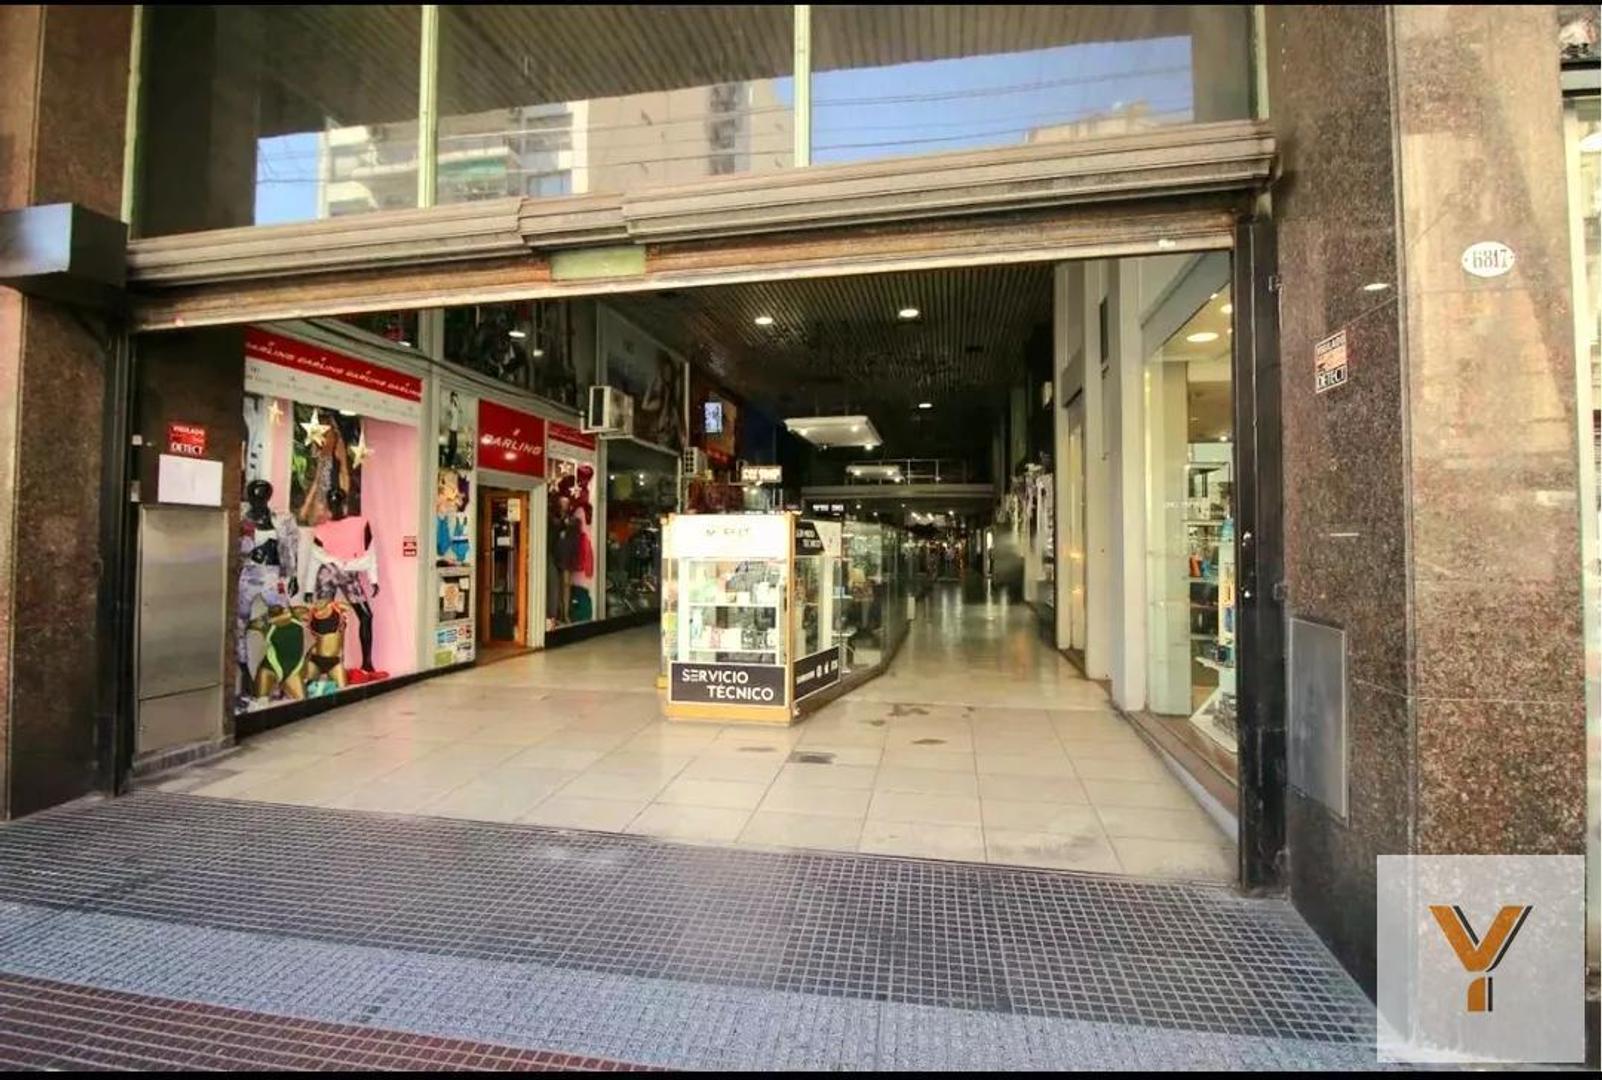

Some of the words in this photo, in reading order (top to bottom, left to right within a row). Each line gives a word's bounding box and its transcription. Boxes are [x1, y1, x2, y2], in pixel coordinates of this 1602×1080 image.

[1472, 249, 1508, 268] 6817
[1316, 367, 1346, 388] DETECT
[170, 443, 204, 455] DETECT
[481, 434, 542, 455] DARLING
[682, 668, 749, 684] SERVICIO
[706, 684, 774, 701] TÉCNICO
